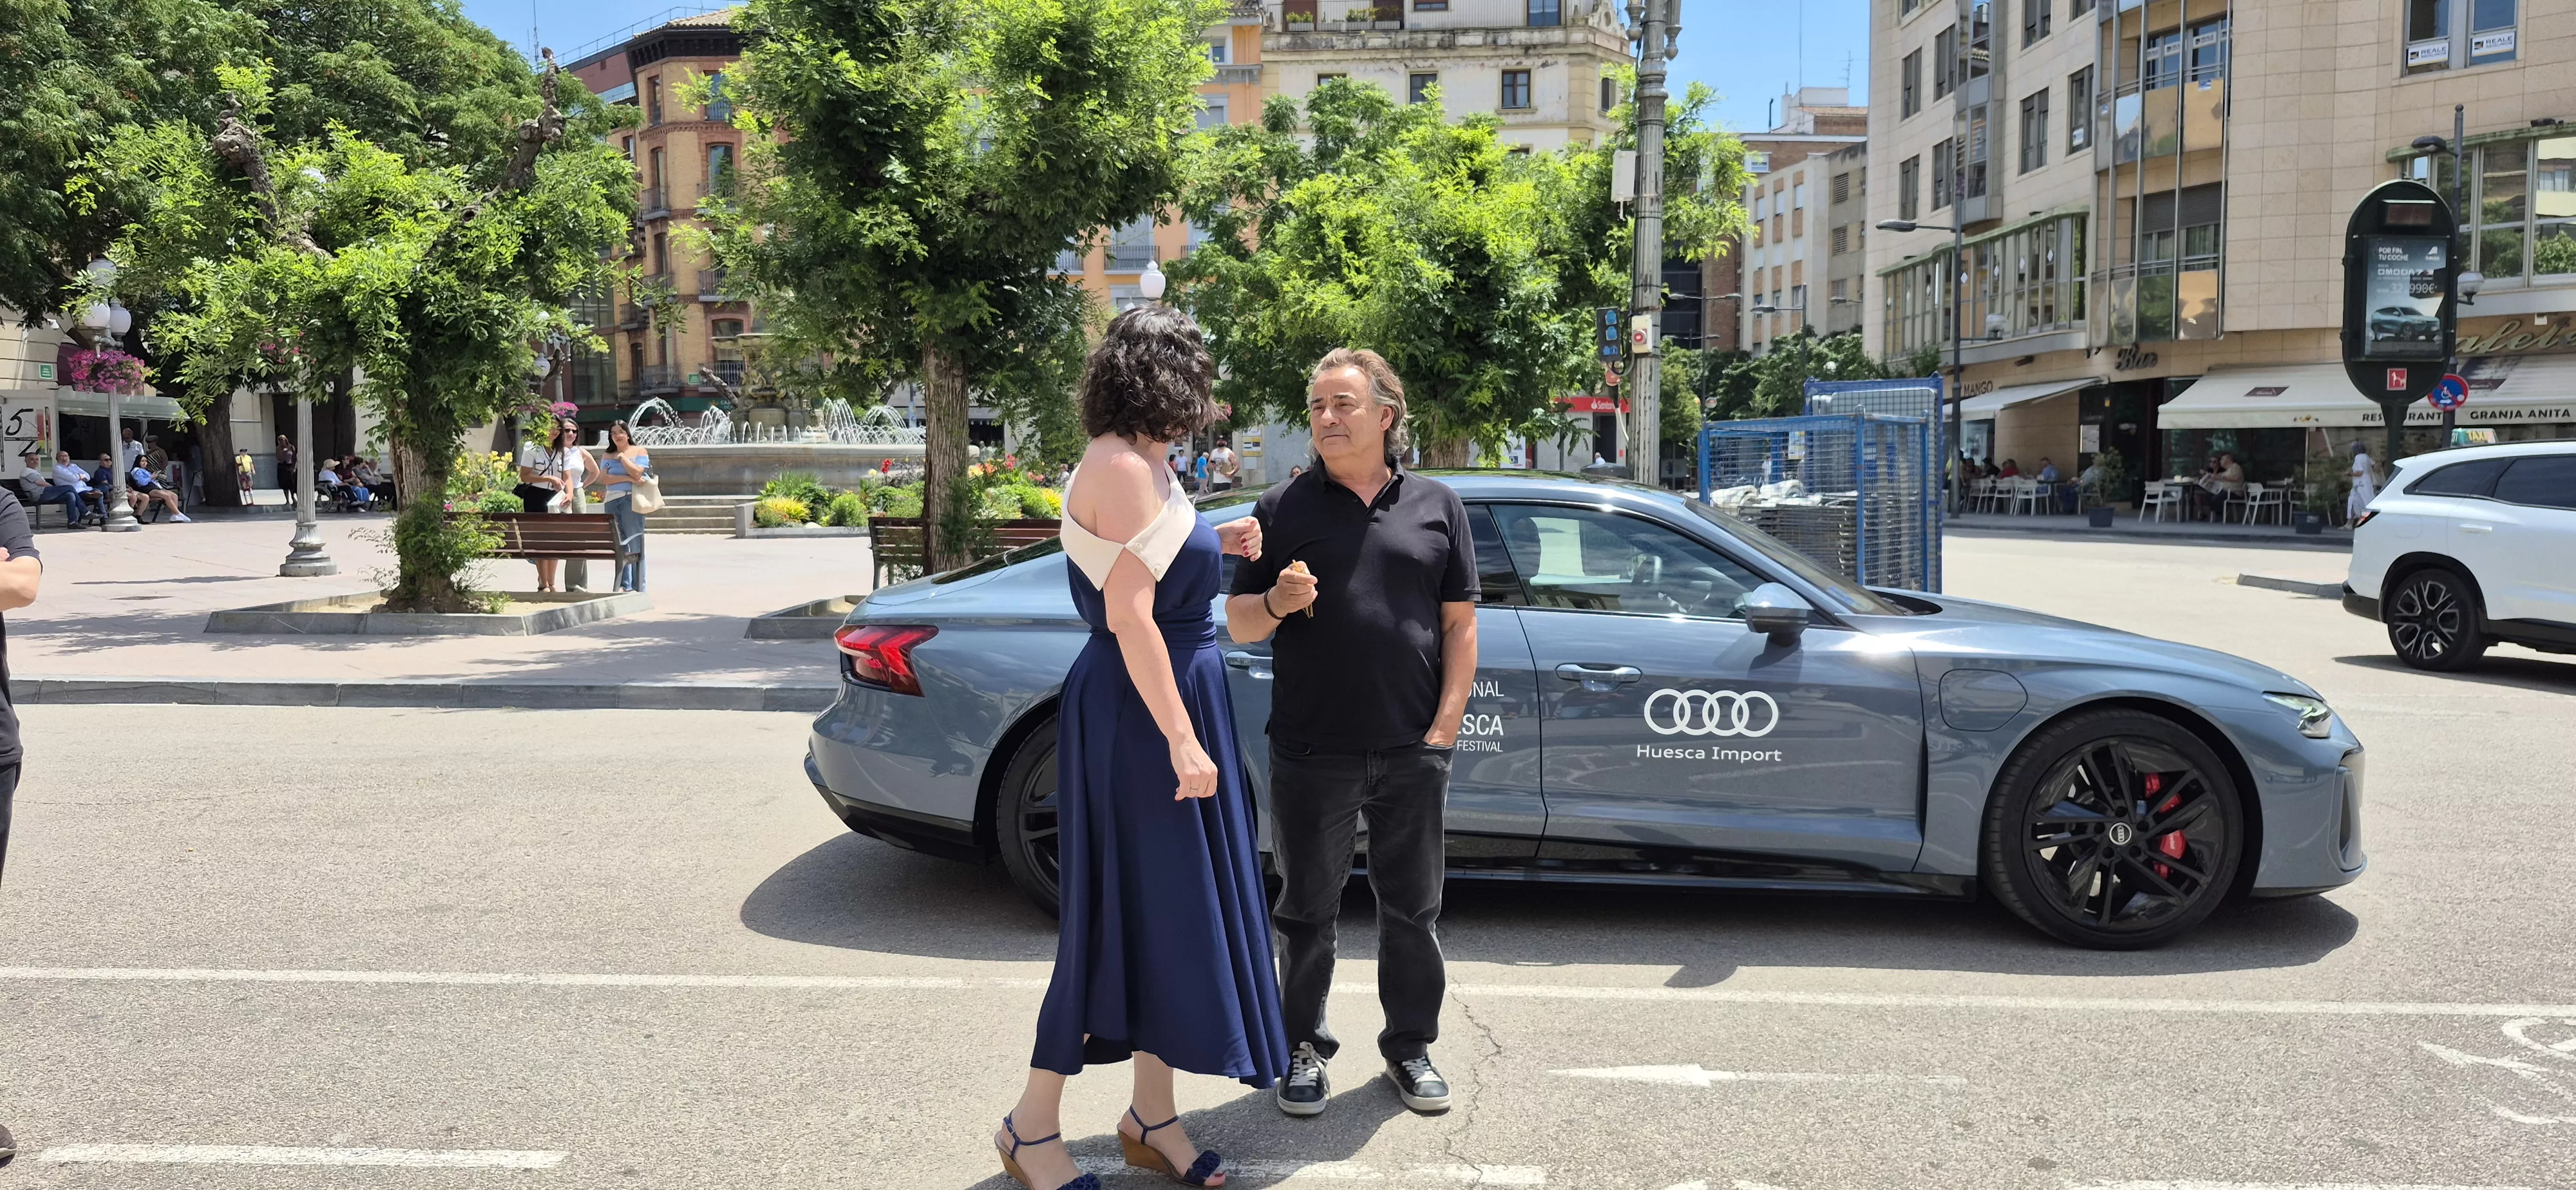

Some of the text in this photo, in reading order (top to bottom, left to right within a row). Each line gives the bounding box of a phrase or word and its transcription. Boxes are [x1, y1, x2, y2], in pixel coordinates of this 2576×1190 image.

[2486, 35, 2513, 44] REALE
[2421, 46, 2447, 55] REALE
[1964, 380, 1993, 397] MANGO
[2362, 408, 2571, 422] RESRANT GRANJA ANITA
[1457, 740, 1503, 753] FESTIVAL
[1636, 744, 1783, 764] Huesca Import
